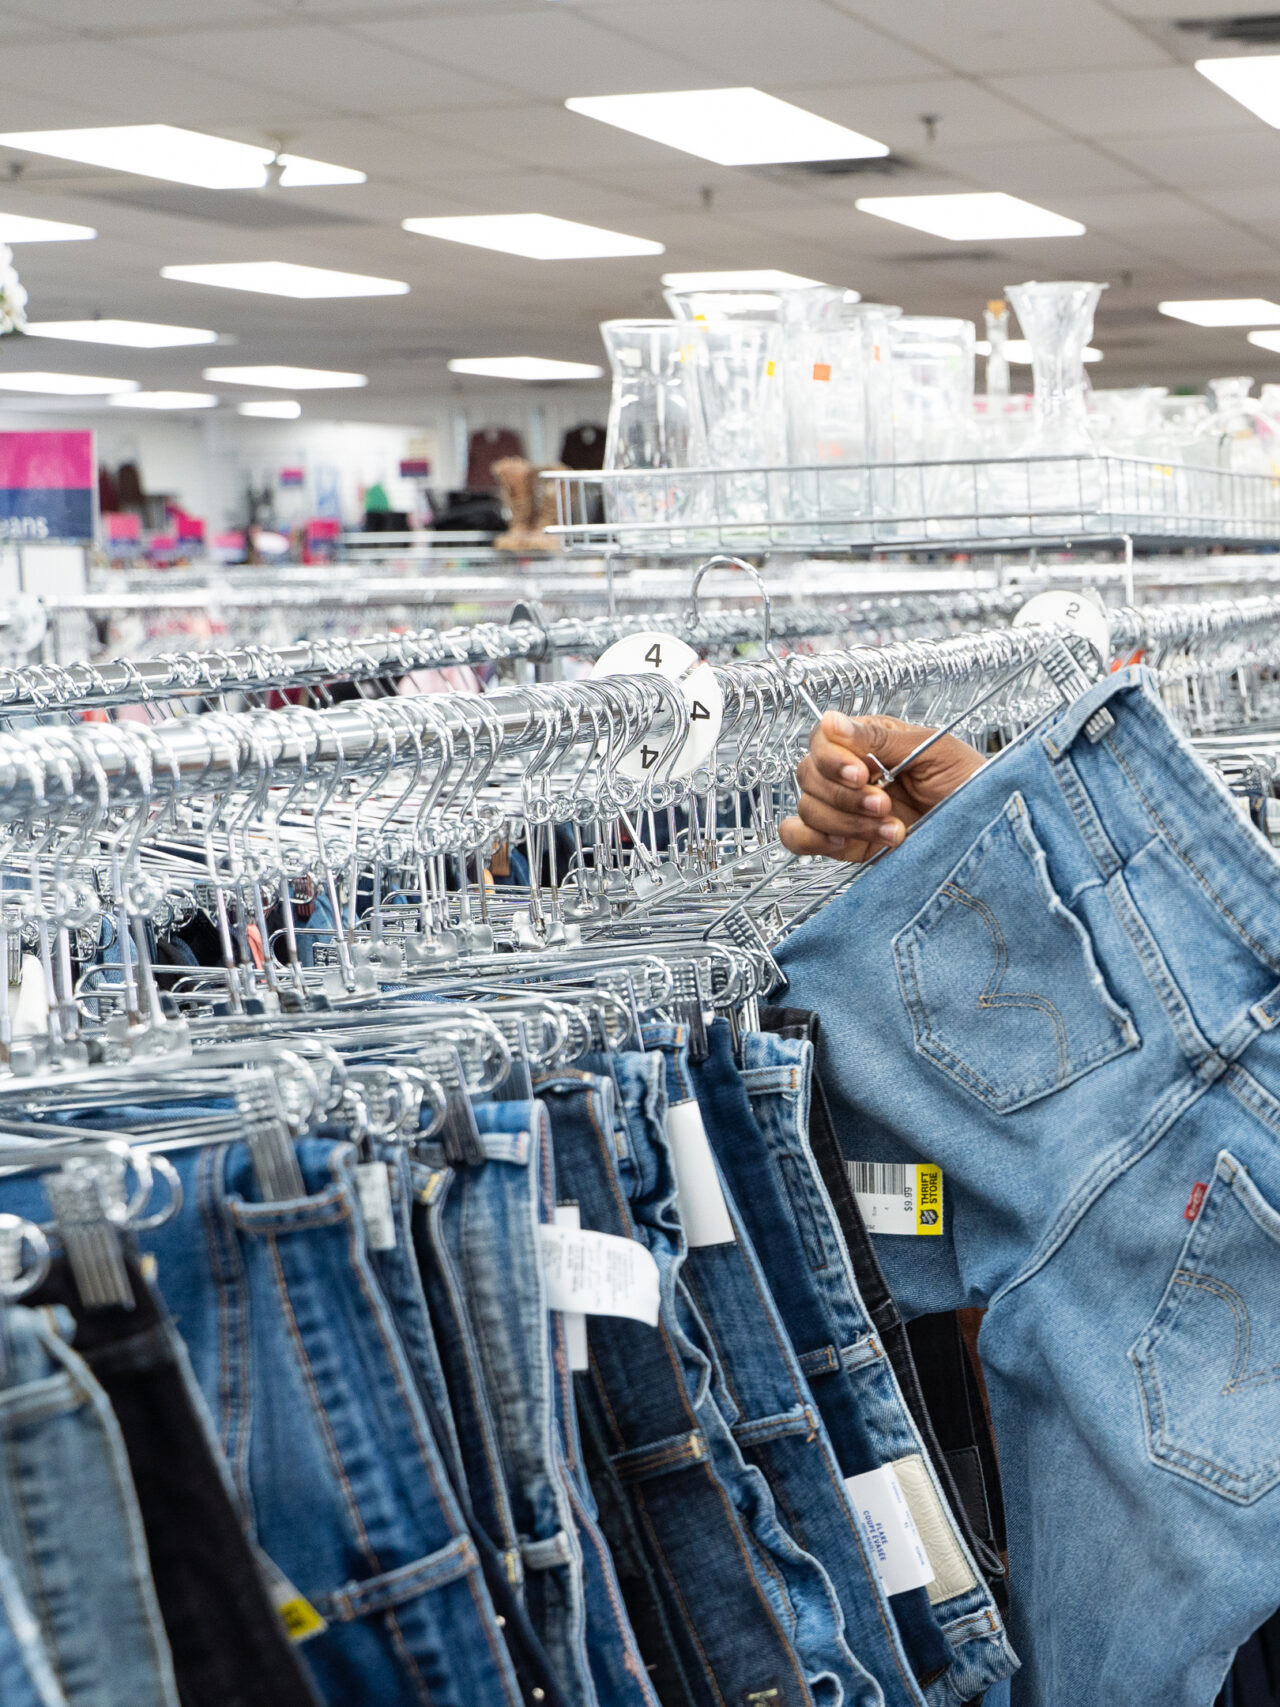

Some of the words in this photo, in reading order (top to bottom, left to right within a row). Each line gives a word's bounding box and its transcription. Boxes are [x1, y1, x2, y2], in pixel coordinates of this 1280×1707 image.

[1065, 602, 1081, 620] 2
[644, 643, 662, 668] 4
[690, 700, 711, 721] 4
[640, 744, 659, 769] 4
[904, 1186, 913, 1212] $9.99
[920, 1171, 929, 1205] THRIFT
[929, 1171, 938, 1204] STORE
[863, 1510, 876, 1534] COUPE
[875, 1522, 888, 1545] FLARE
